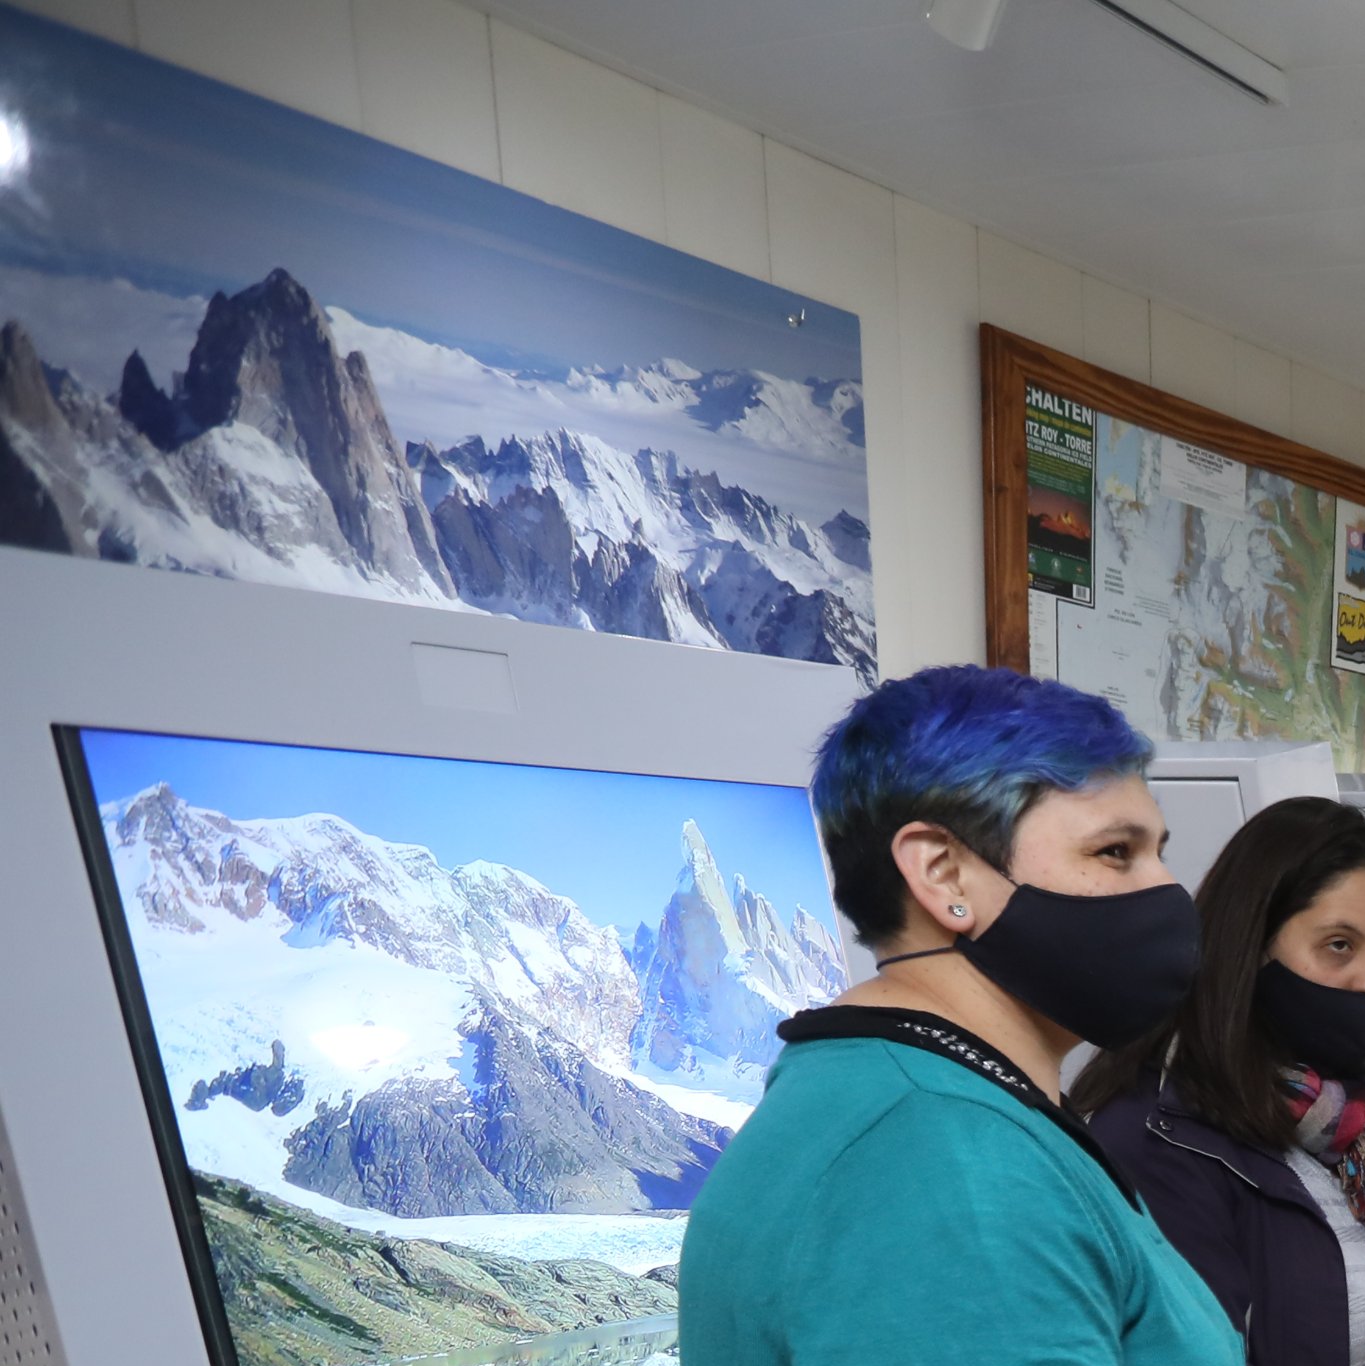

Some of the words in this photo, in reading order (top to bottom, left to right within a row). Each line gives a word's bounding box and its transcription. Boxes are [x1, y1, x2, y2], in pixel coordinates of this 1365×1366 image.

[1041, 425, 1058, 443] ROY
[1064, 433, 1092, 455] TORRE
[1339, 611, 1356, 627] Out
